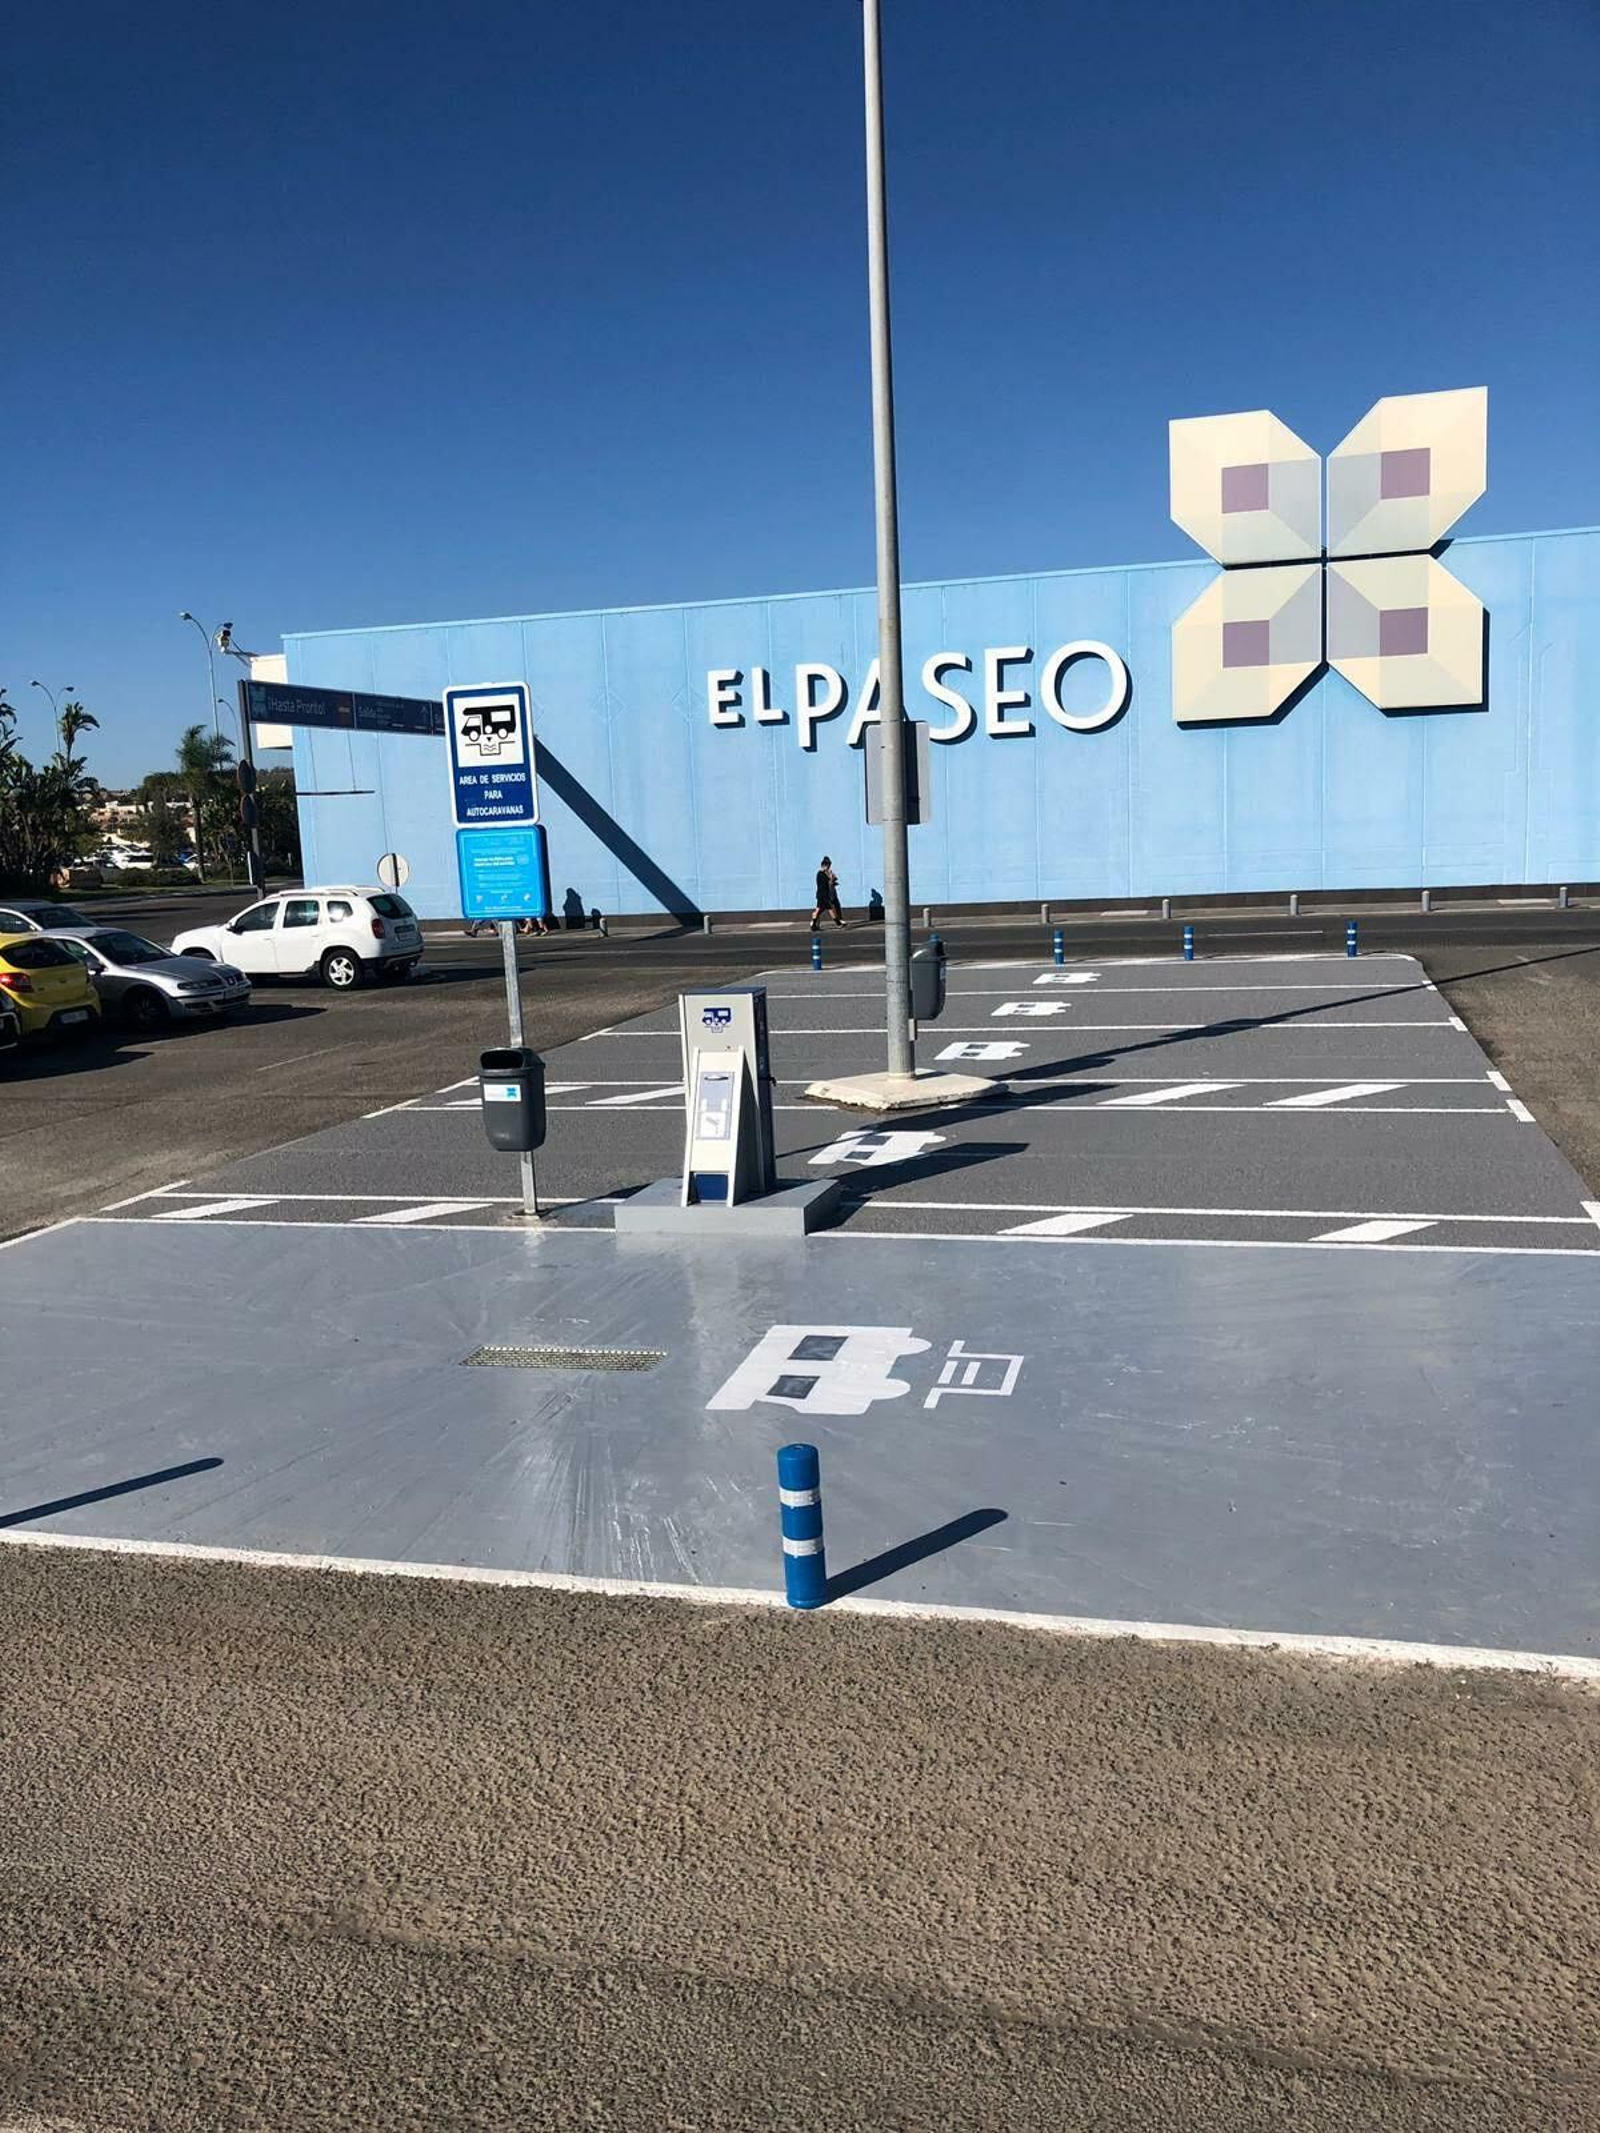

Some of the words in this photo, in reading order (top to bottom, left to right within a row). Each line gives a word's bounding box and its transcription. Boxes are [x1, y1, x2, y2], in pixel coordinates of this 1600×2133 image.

[459, 775, 478, 785] AREA
[480, 774, 489, 784] DE
[491, 772, 526, 783] SERVICIOS
[484, 789, 503, 800] PARA
[466, 805, 524, 817] AUTOCARAVANAS
